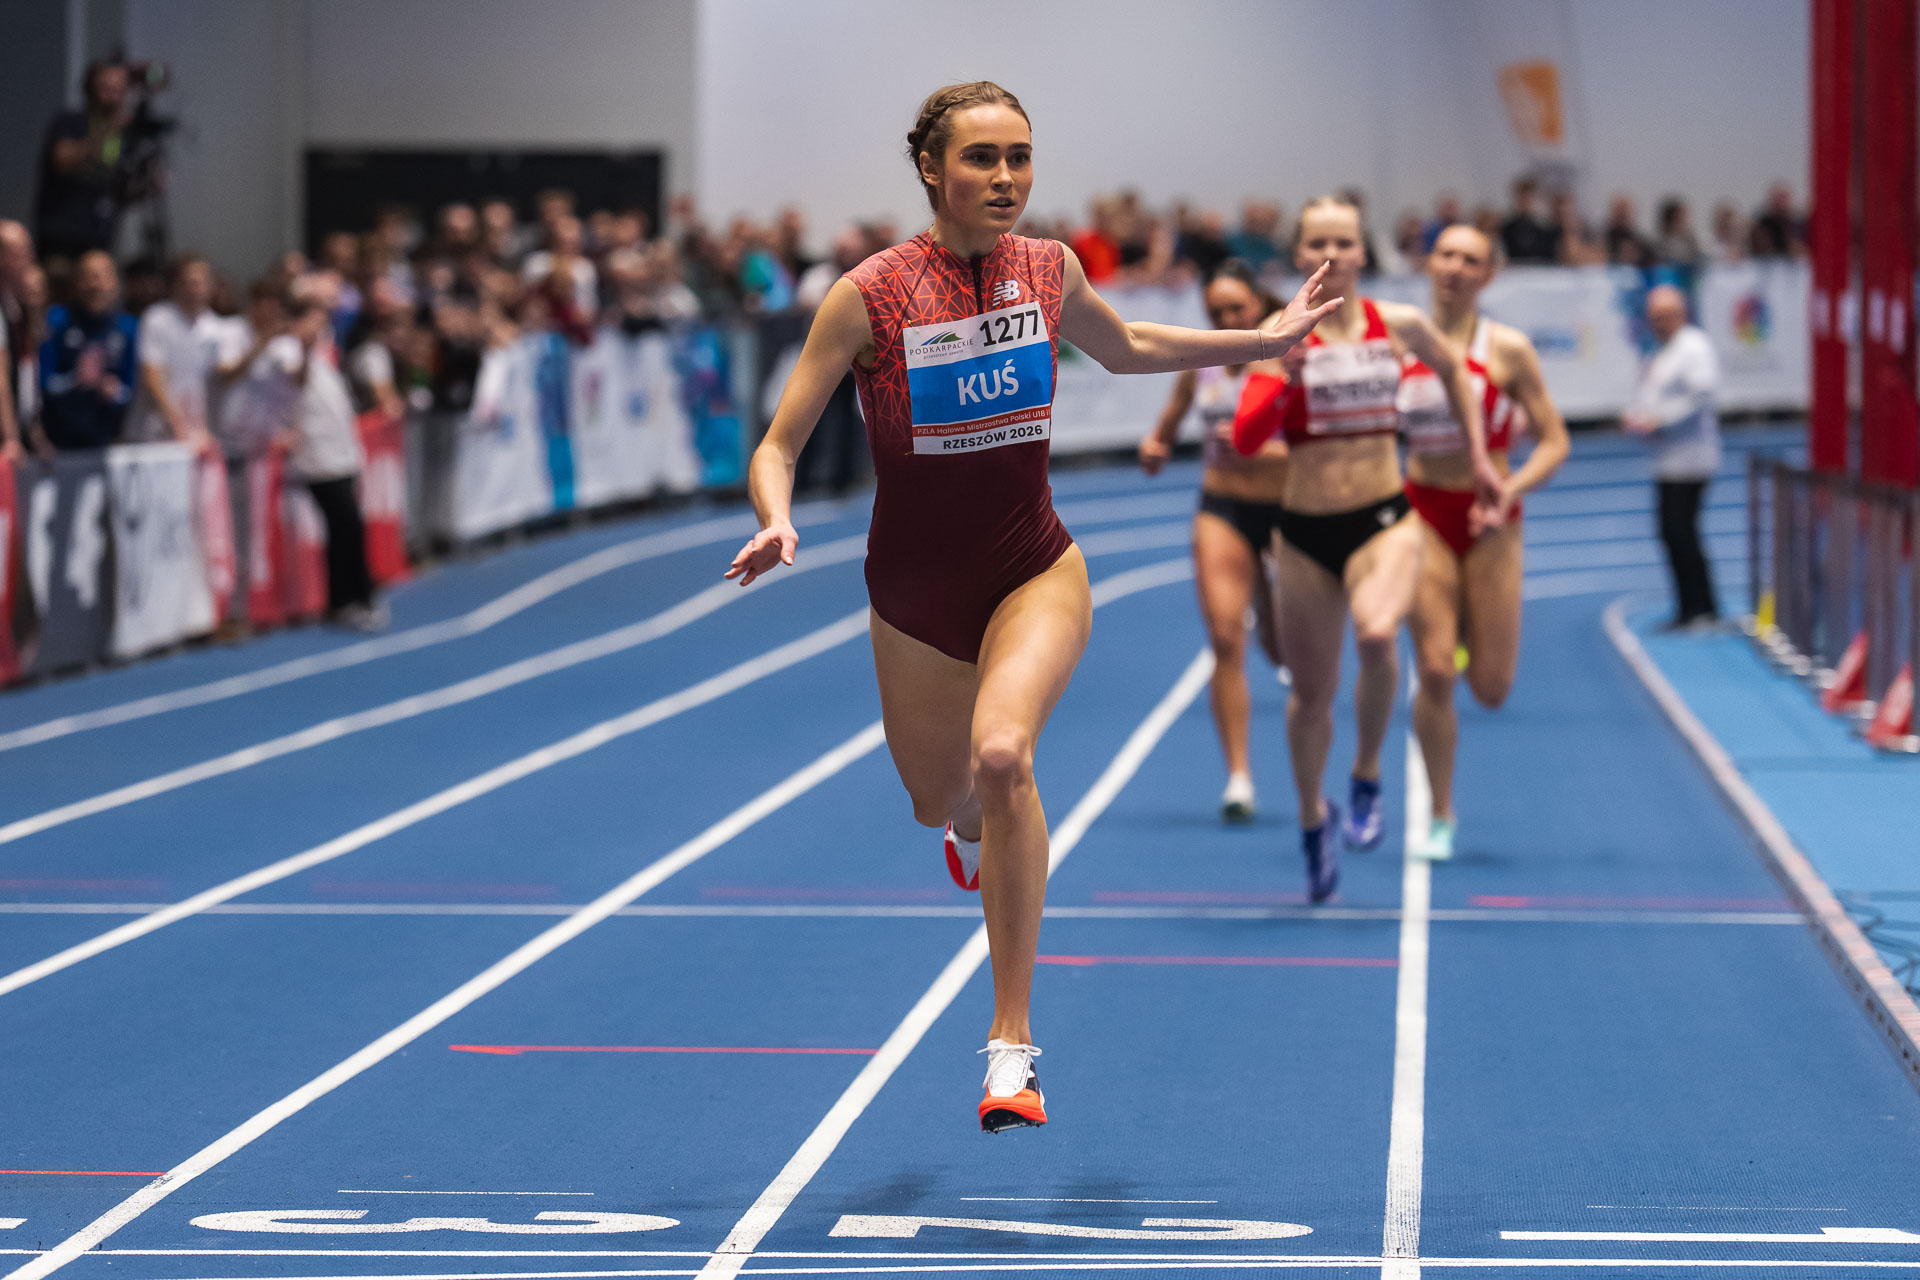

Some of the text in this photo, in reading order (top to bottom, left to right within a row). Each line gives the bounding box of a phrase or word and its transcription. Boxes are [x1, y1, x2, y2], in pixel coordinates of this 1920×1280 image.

[979, 309, 1038, 347] 1277
[909, 338, 974, 356] PODKARPACKIE
[957, 358, 1019, 406] KUŚ
[917, 427, 936, 435] PZLA
[936, 425, 966, 435] Halowe
[966, 418, 1009, 432] Mistrzostwa
[1010, 411, 1031, 422] Polski
[1032, 409, 1046, 419] U18
[943, 424, 1043, 450] RZESZÓW 2026
[189, 1209, 681, 1236] 3
[827, 1214, 1314, 1241] 2
